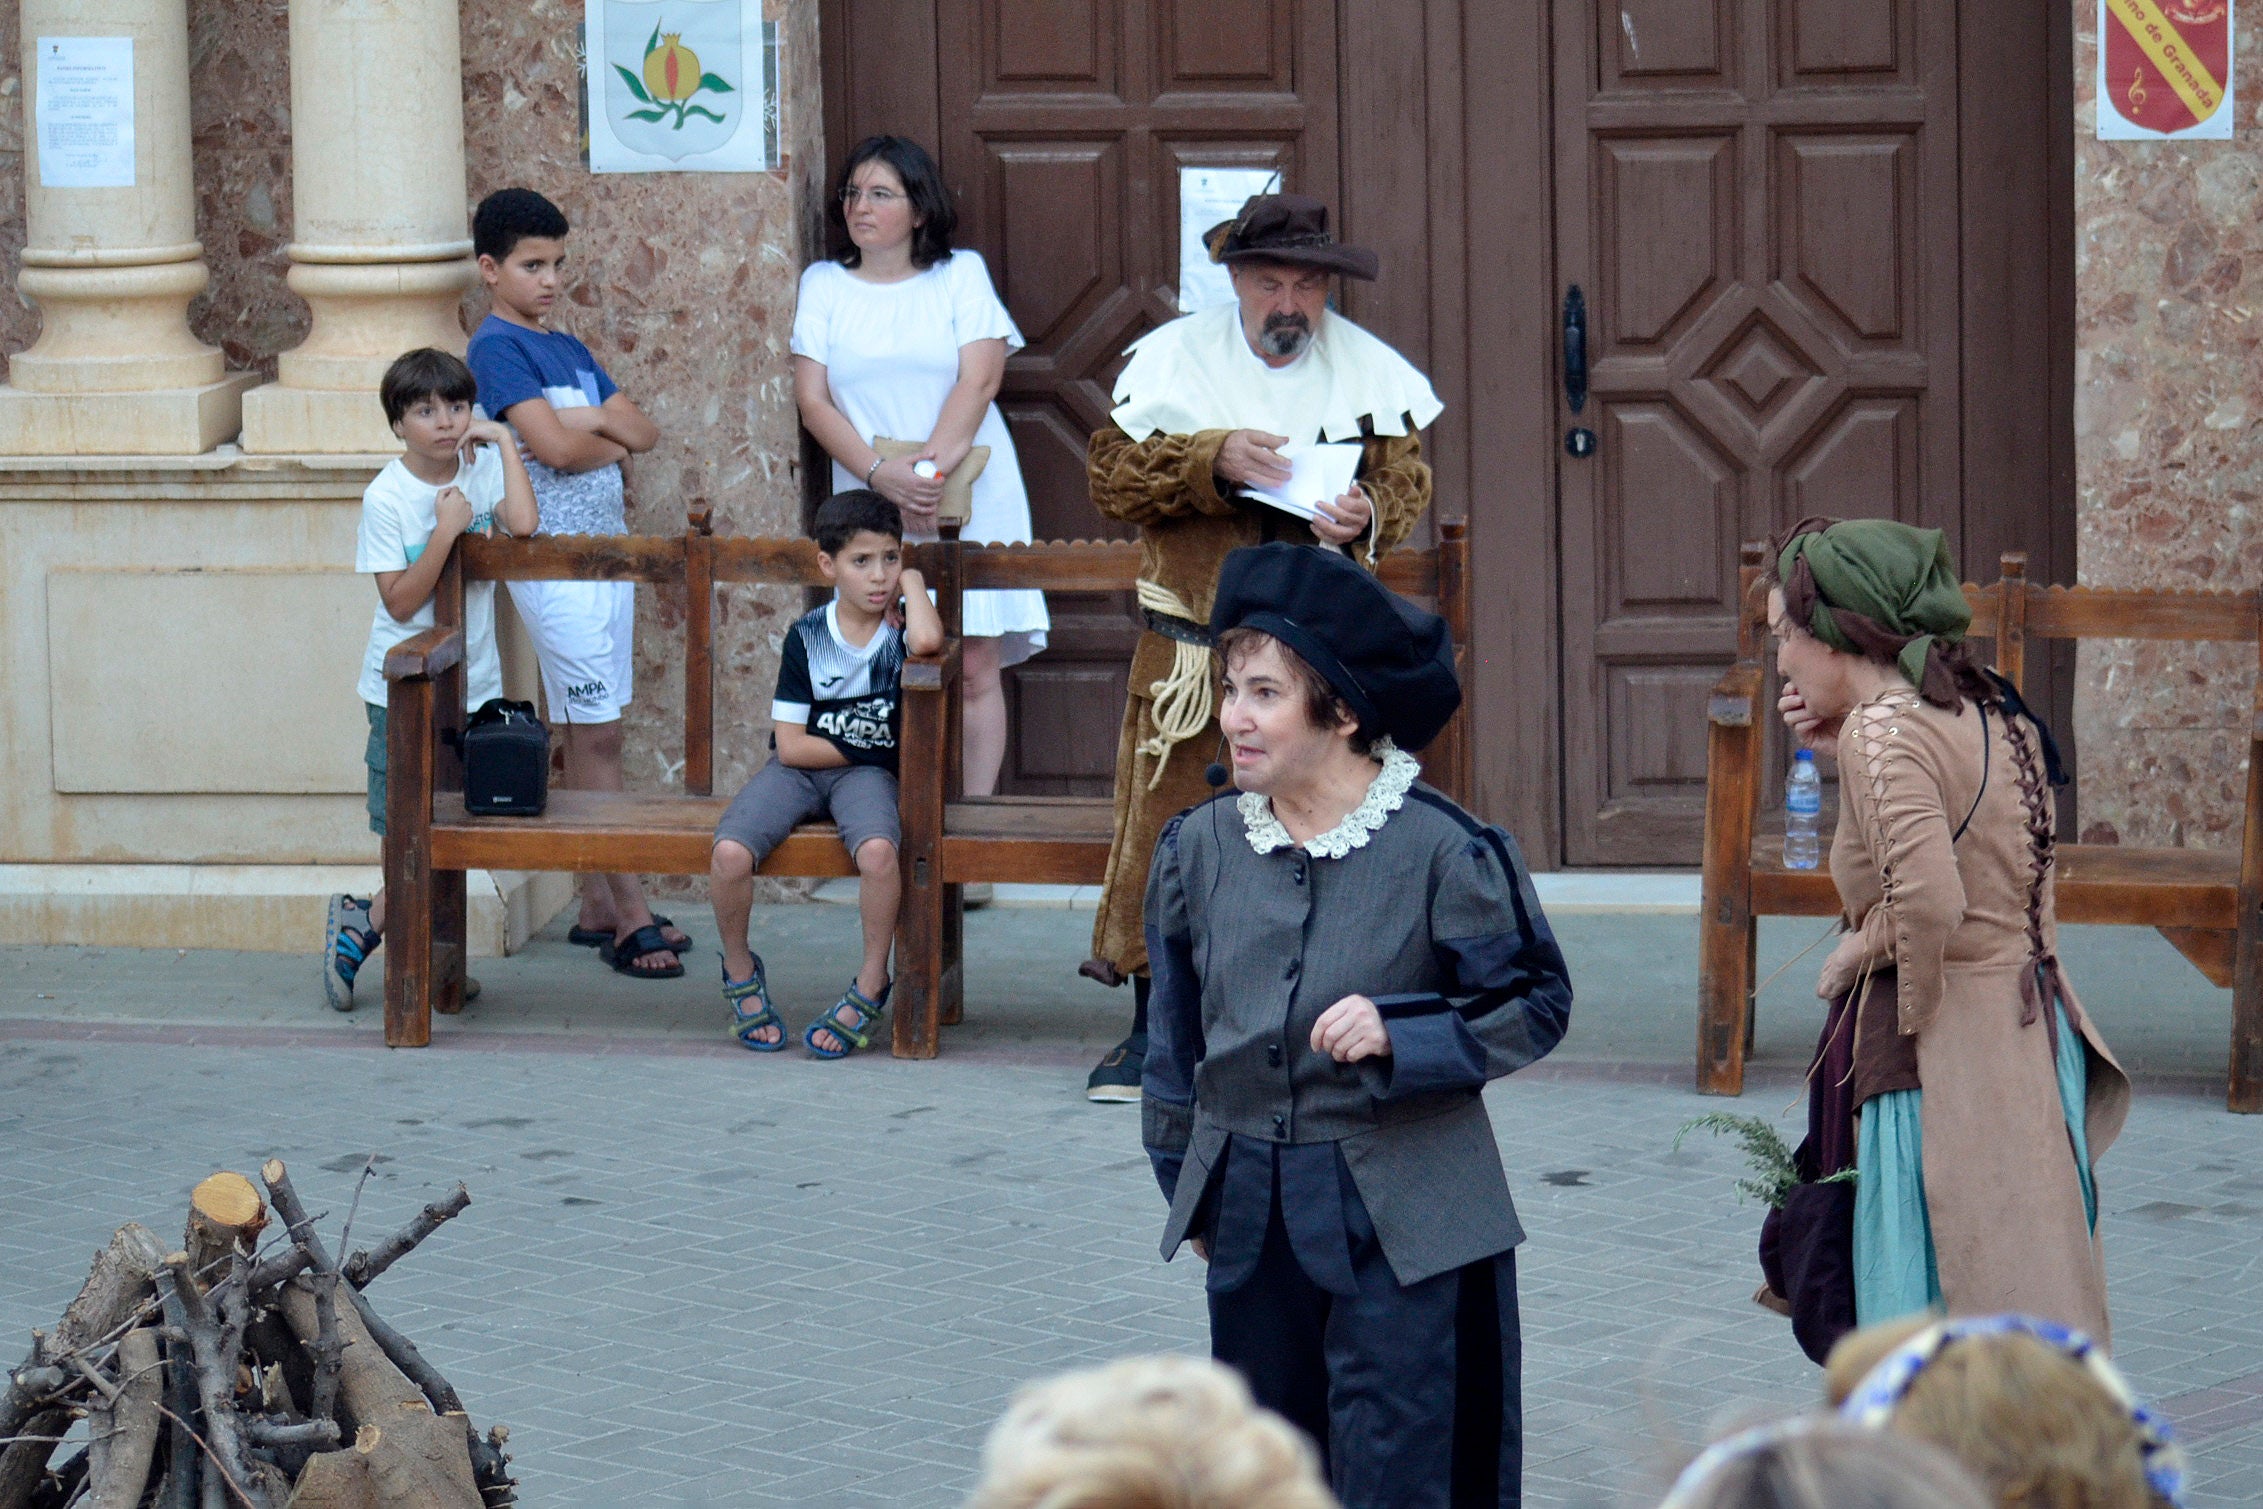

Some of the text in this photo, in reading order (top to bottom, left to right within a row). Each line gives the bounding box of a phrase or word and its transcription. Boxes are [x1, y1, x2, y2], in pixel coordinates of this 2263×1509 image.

[2145, 23, 2162, 43] de
[2163, 44, 2213, 108] Granada
[567, 680, 607, 699] AMPA
[816, 711, 893, 740] AMPA
